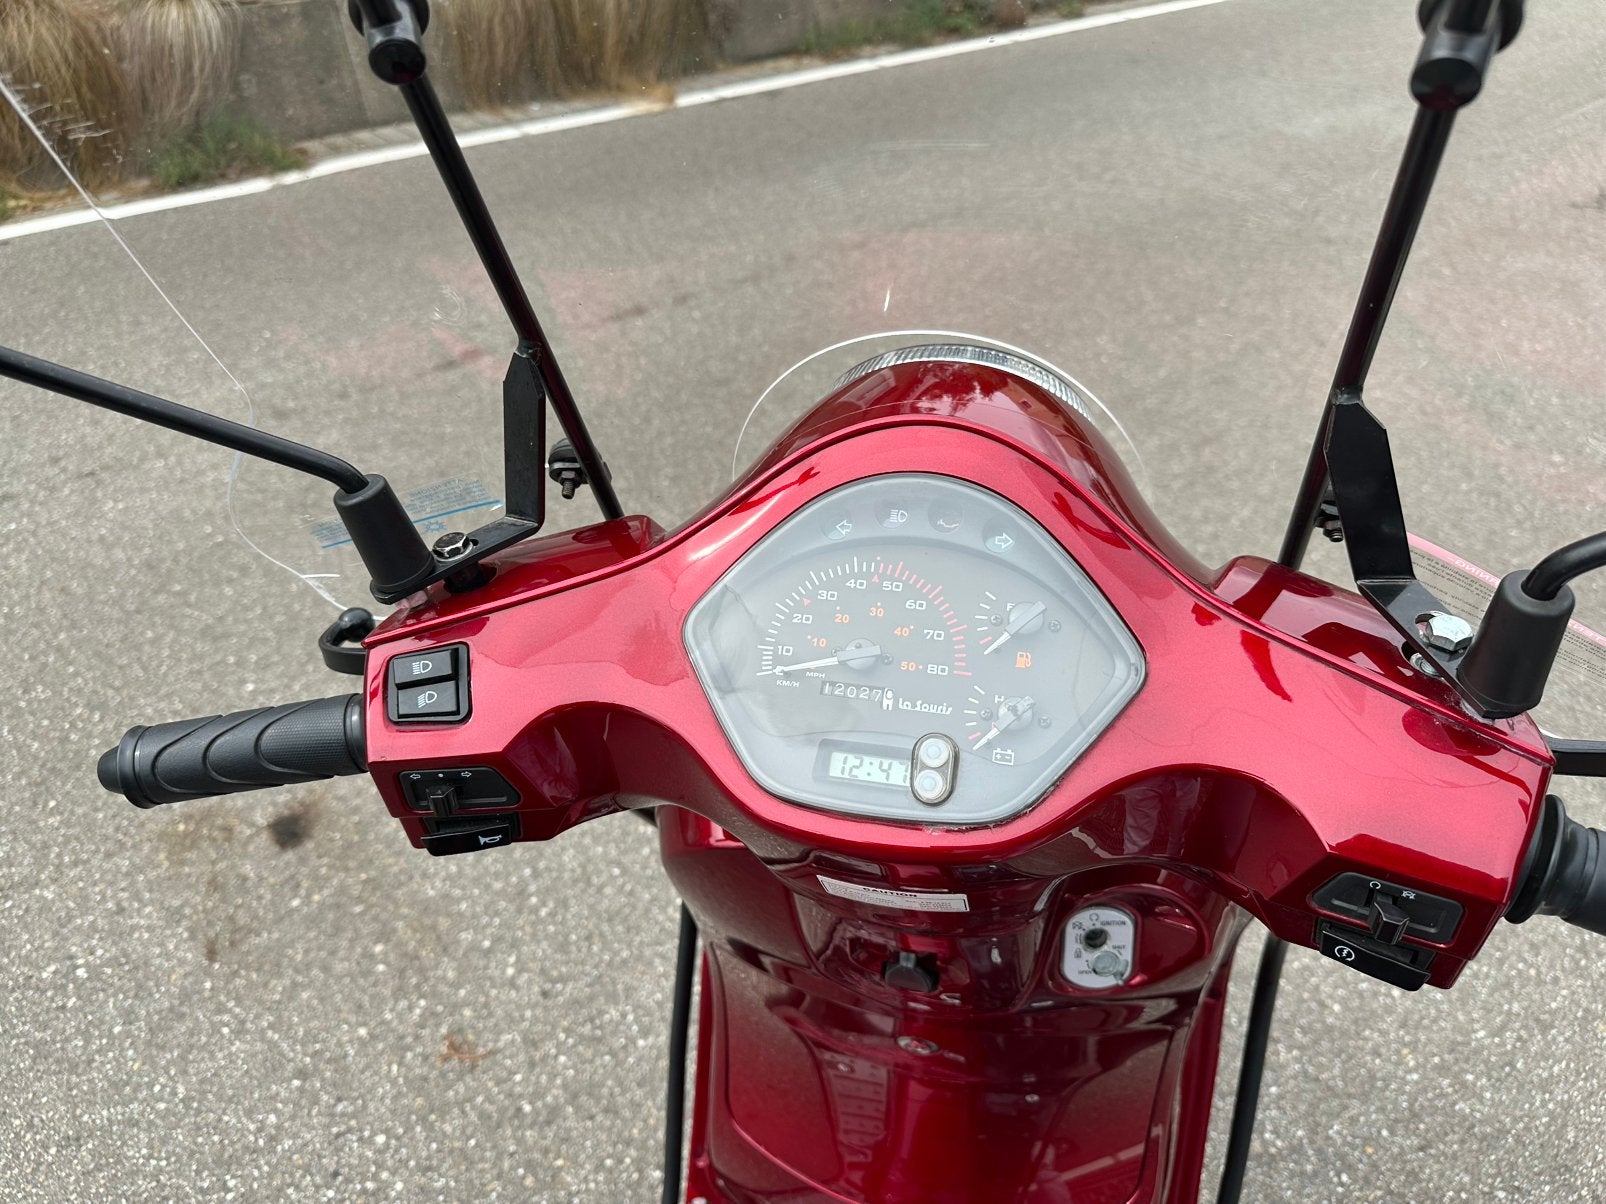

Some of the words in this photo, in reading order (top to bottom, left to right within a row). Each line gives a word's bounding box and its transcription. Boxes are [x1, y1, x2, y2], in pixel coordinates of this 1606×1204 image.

[845, 579, 867, 589] 40
[882, 581, 903, 592] 50
[817, 590, 838, 600] 30
[905, 600, 927, 610] 60
[869, 608, 884, 617] 30
[791, 613, 813, 624] 20
[834, 614, 850, 623] 20
[893, 627, 910, 637] 40
[923, 629, 945, 641] 70
[811, 637, 826, 647] 10
[777, 645, 793, 656] 10
[900, 661, 917, 672] 50
[926, 664, 949, 676] 80
[805, 671, 826, 679] MPH
[776, 679, 800, 688] KM/H
[840, 755, 910, 784] 12:47
[862, 887, 918, 898] CAUTION
